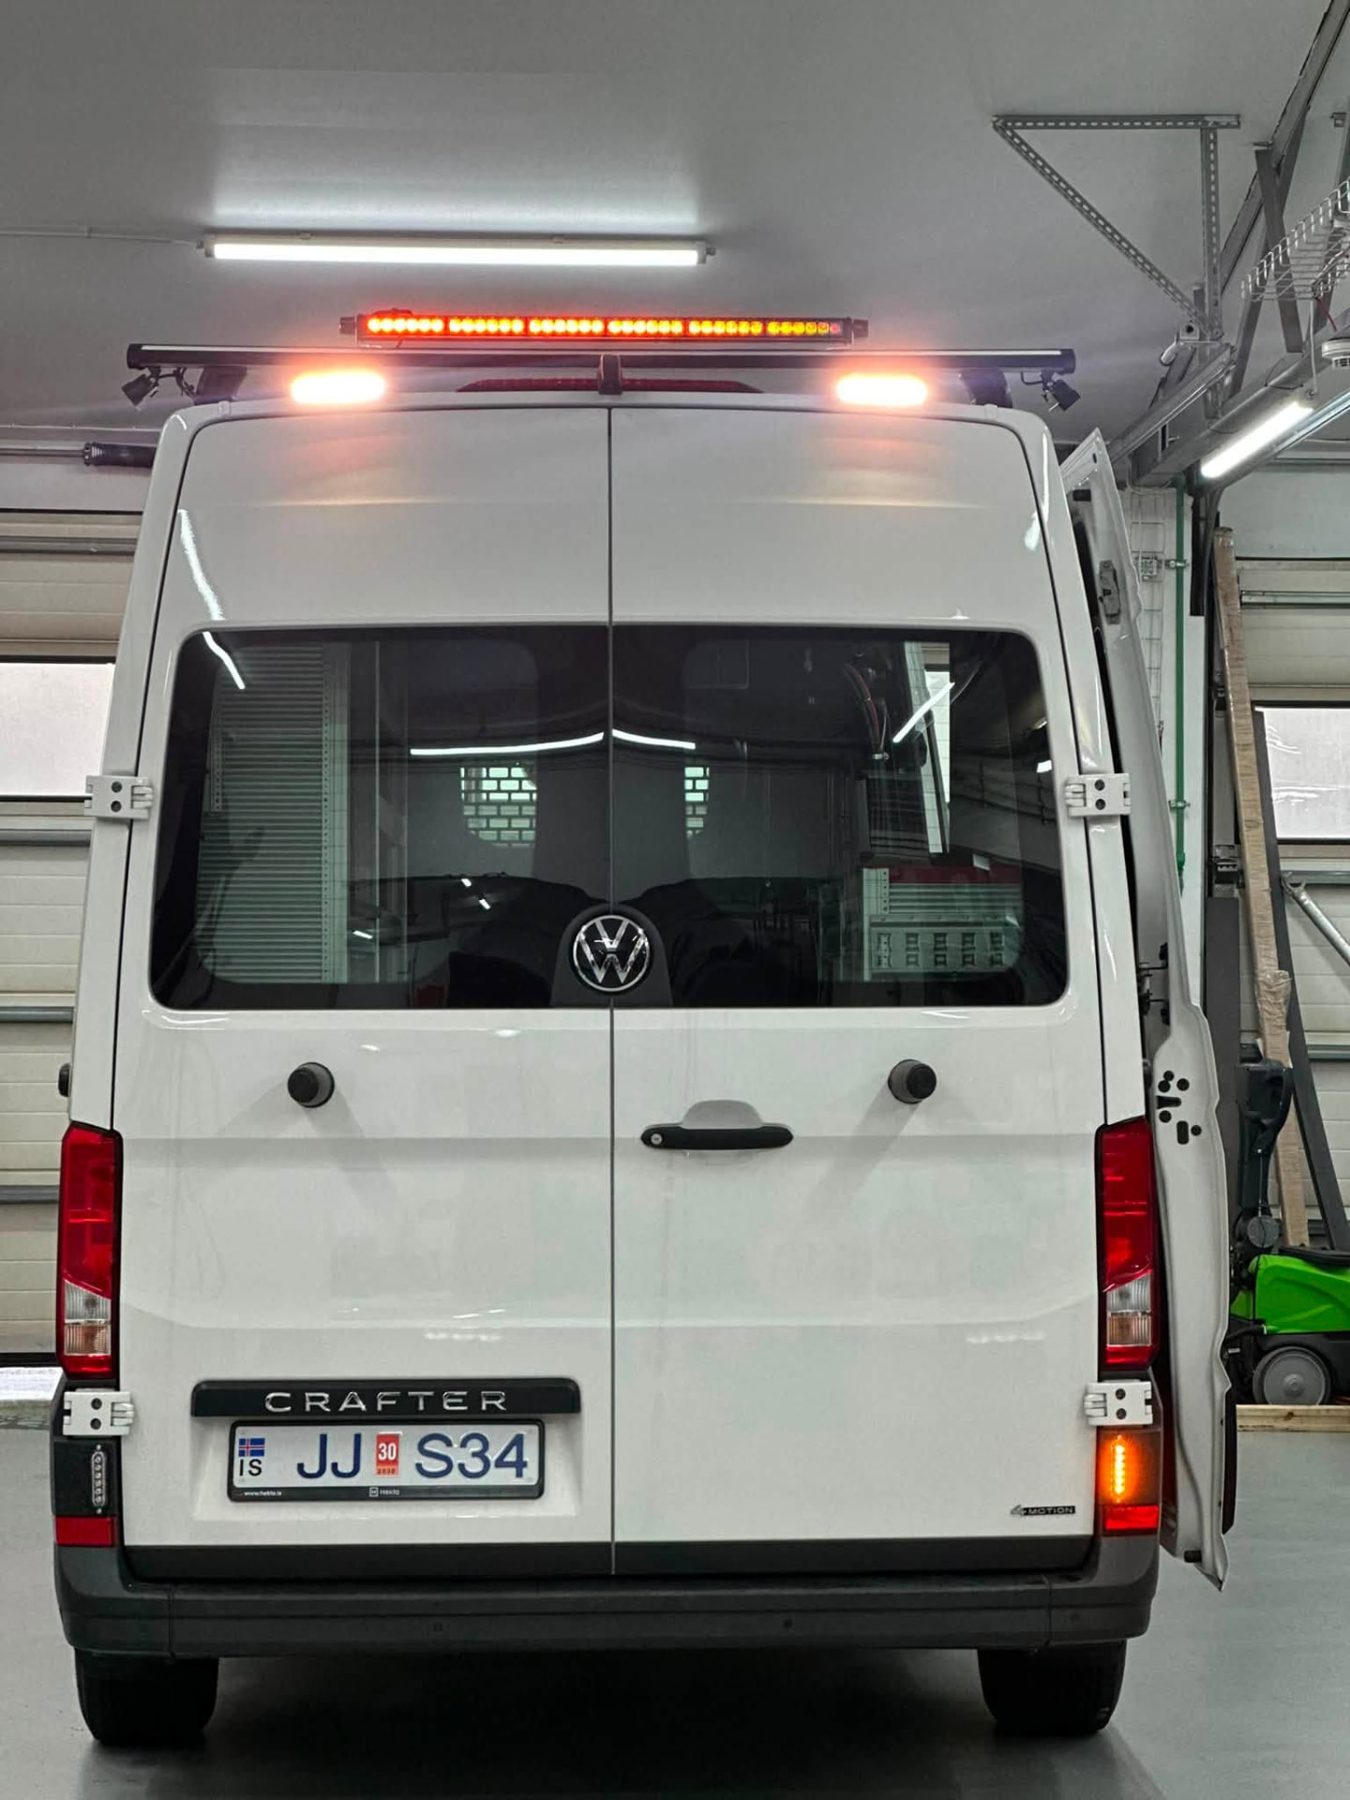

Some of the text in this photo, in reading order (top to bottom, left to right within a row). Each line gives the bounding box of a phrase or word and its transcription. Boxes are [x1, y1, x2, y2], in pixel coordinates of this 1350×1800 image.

[265, 1391, 507, 1412] CRAFTER
[297, 1432, 528, 1479] JJ S34
[378, 1442, 397, 1461] 30
[239, 1458, 263, 1476] IS
[1010, 1504, 1075, 1516] 4MOTION
